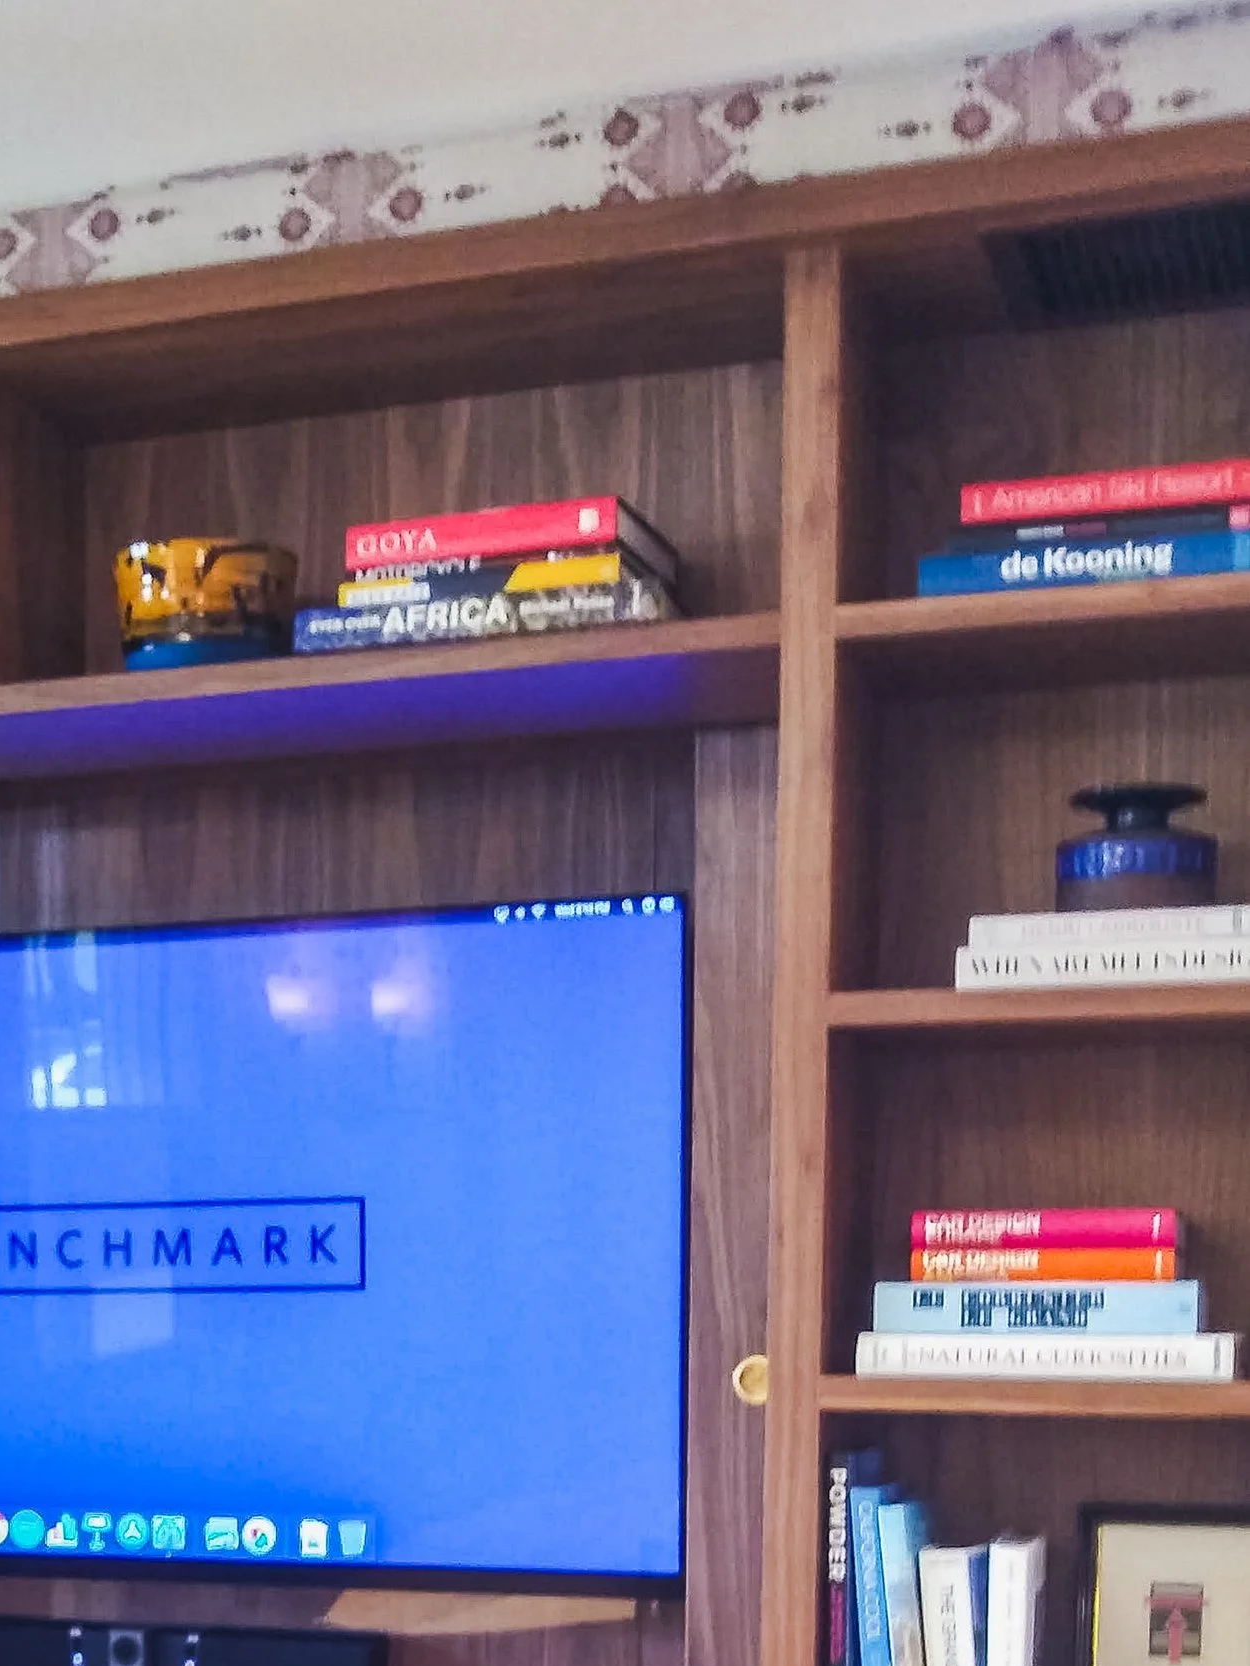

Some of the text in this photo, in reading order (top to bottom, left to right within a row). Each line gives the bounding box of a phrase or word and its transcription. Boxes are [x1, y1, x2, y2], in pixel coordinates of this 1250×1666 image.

[356, 527, 438, 555] GOYA
[1000, 541, 1173, 582] de Kooning
[382, 594, 508, 636] AFRICA
[828, 1467, 848, 1583] POWDER
